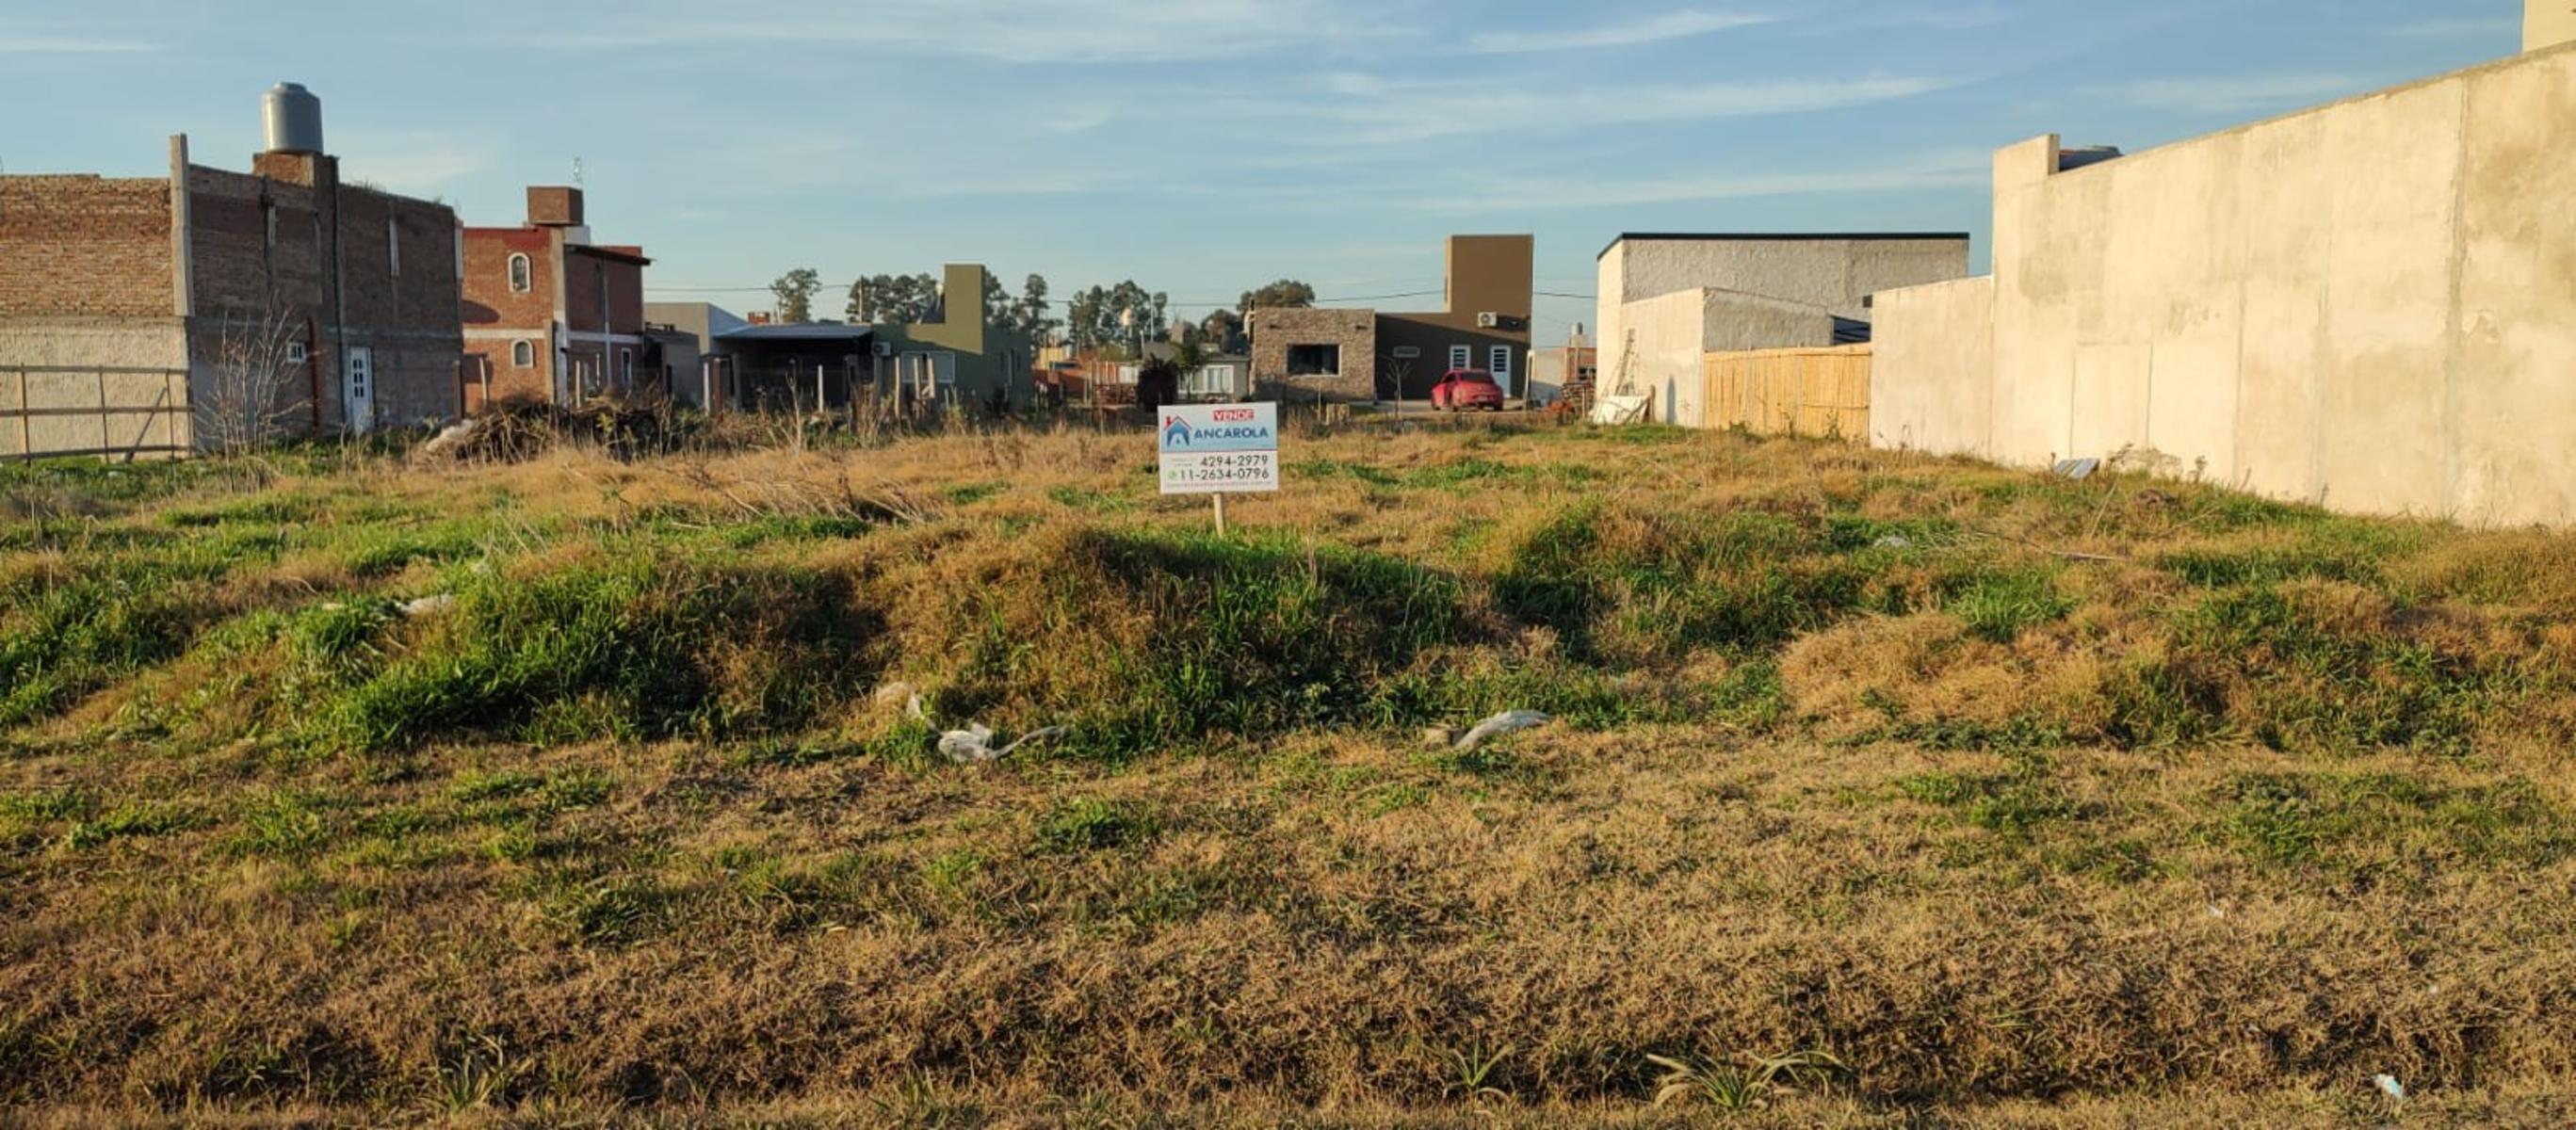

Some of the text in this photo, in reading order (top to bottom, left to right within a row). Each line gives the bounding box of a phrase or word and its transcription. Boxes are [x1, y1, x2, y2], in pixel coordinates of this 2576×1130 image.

[1214, 410, 1254, 420] VENDE
[1193, 428, 1269, 439] ANCAROLA
[1200, 455, 1268, 467] 4294-2979
[1180, 468, 1270, 480] 11-2634-0796
